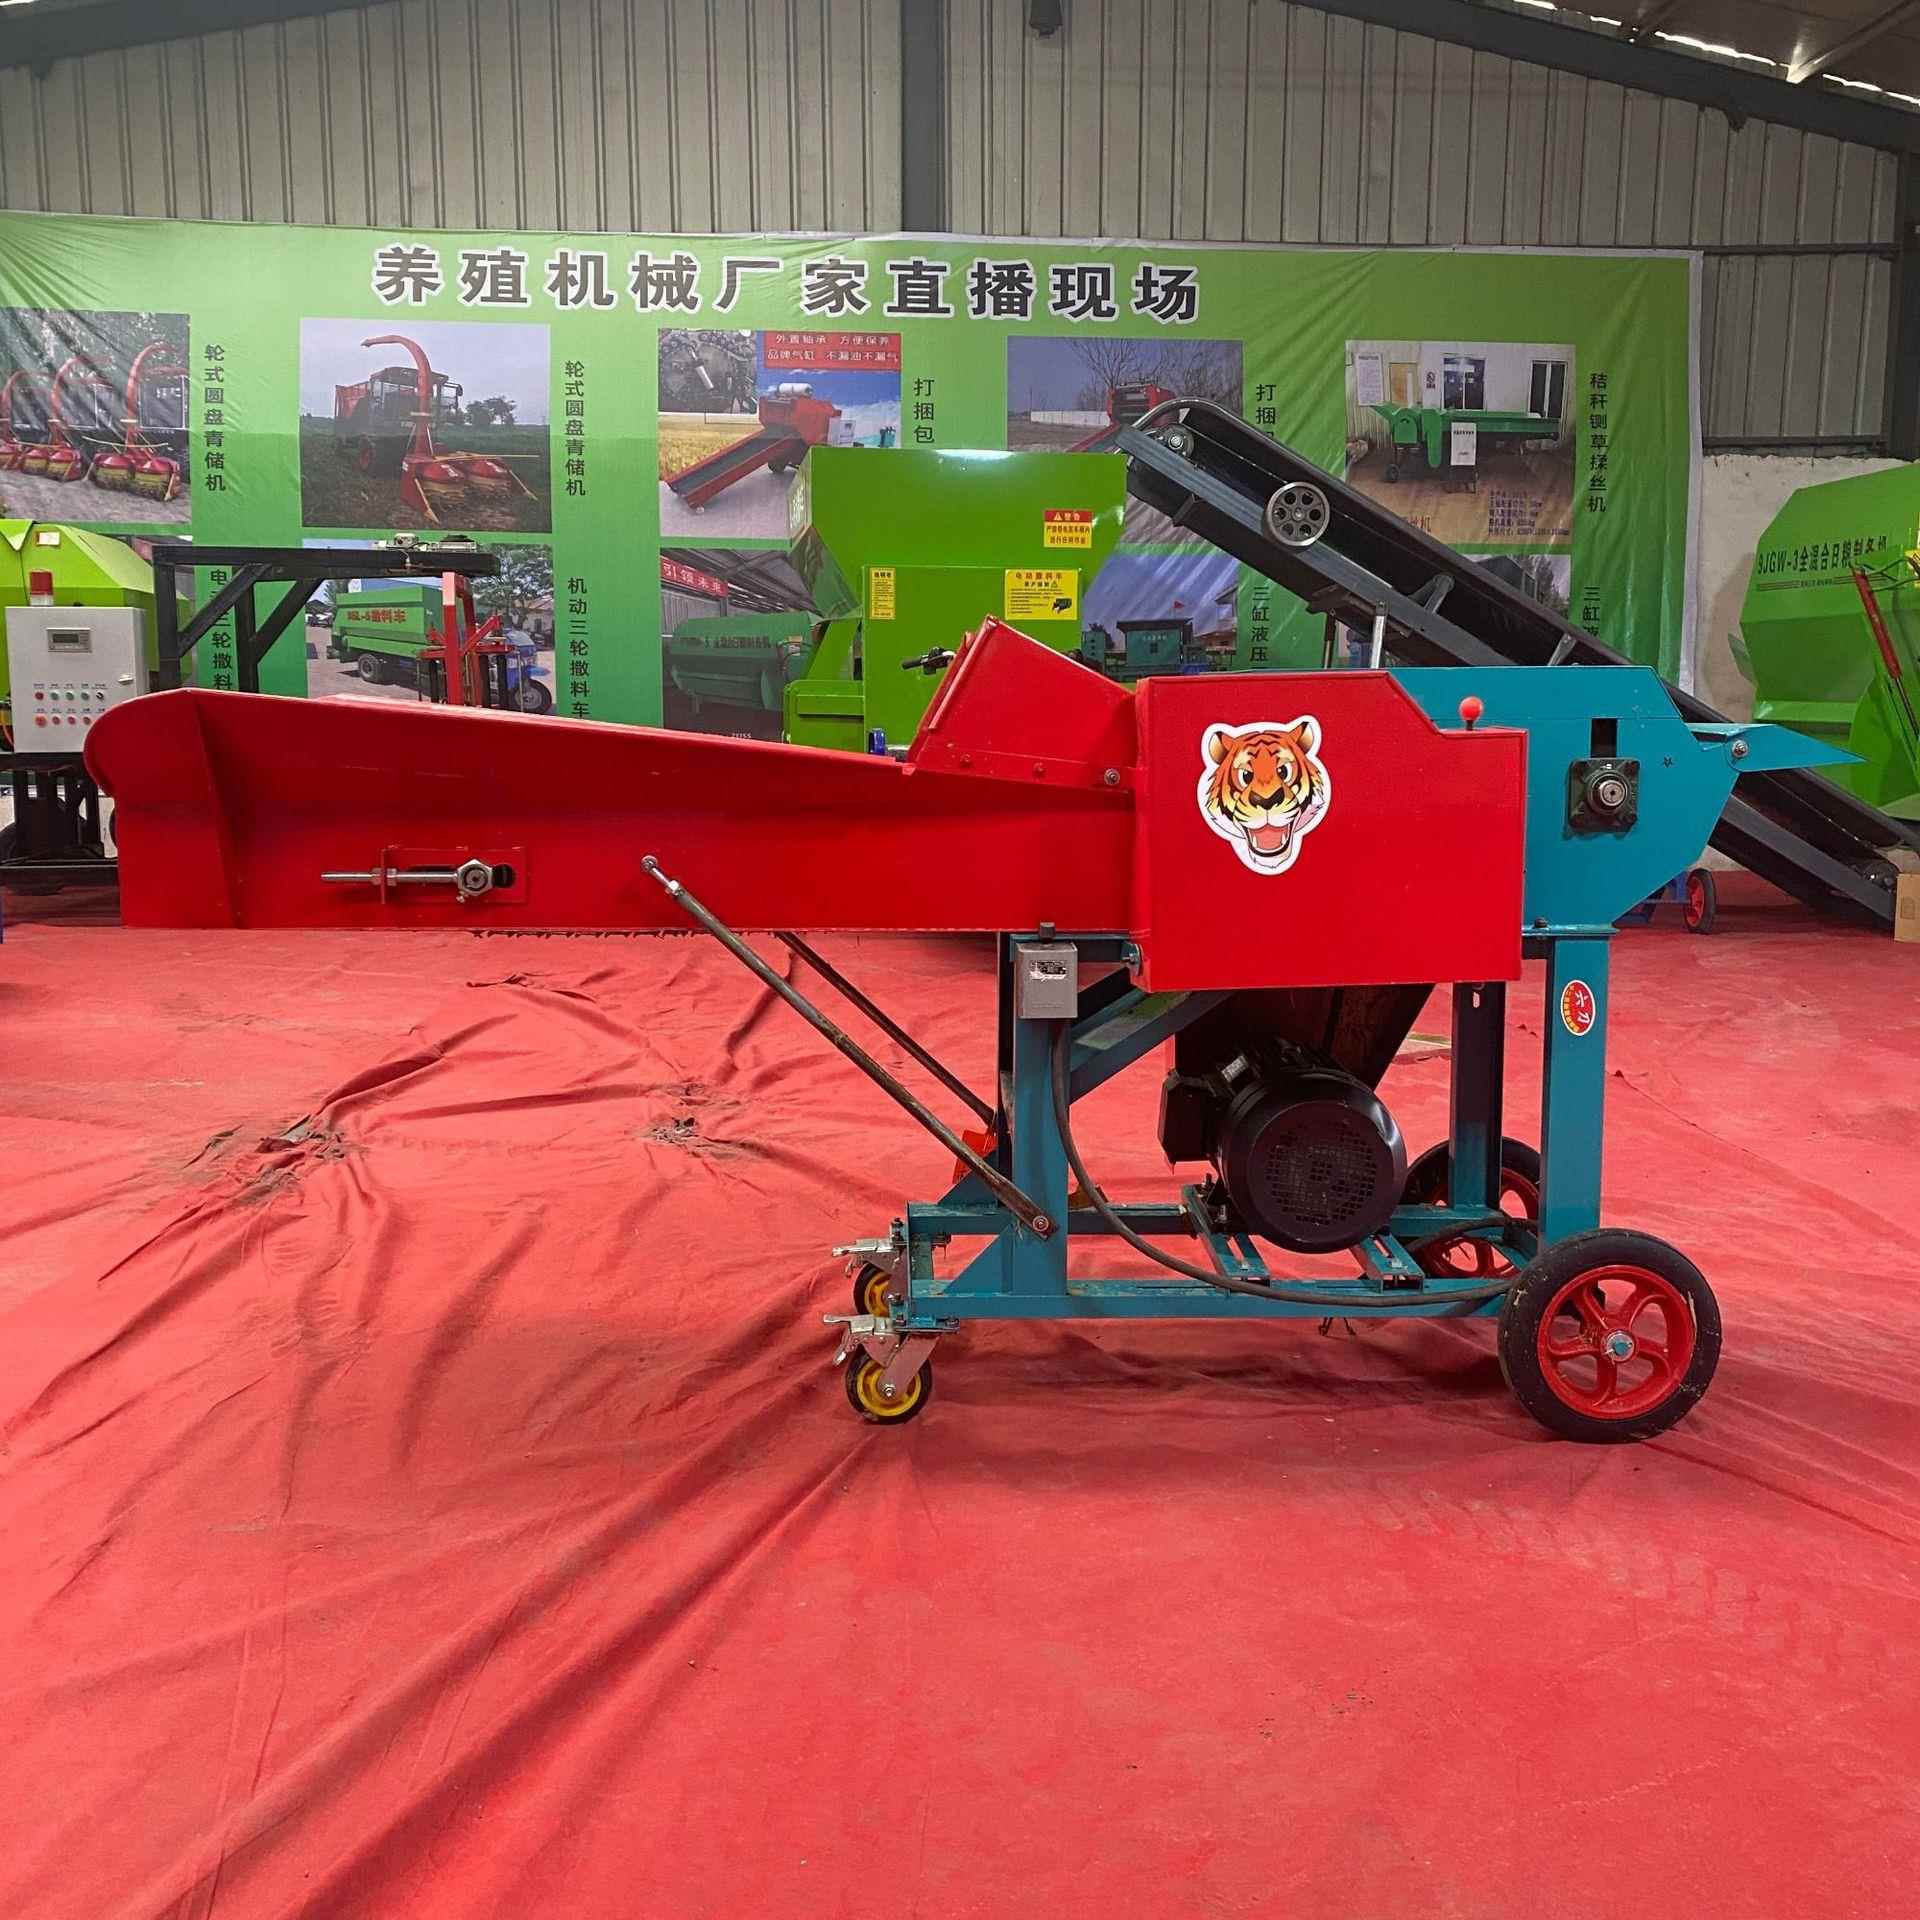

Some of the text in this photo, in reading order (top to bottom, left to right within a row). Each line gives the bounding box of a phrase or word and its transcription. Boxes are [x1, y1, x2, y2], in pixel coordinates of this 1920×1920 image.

[374, 246, 1199, 321] 养殖机械厂家直播现场
[204, 344, 226, 492] 轮式圆盘青储机
[565, 360, 586, 496] 轮式圆盘青储机
[913, 378, 935, 443] 打捆包
[1255, 384, 1277, 437] 打捆
[1589, 373, 1608, 513] 秸秆铡草揉丝机
[209, 568, 233, 690] 电三轮撒料
[568, 577, 590, 718] 机动三轮撒料车
[1250, 586, 1270, 669] 三缸液压
